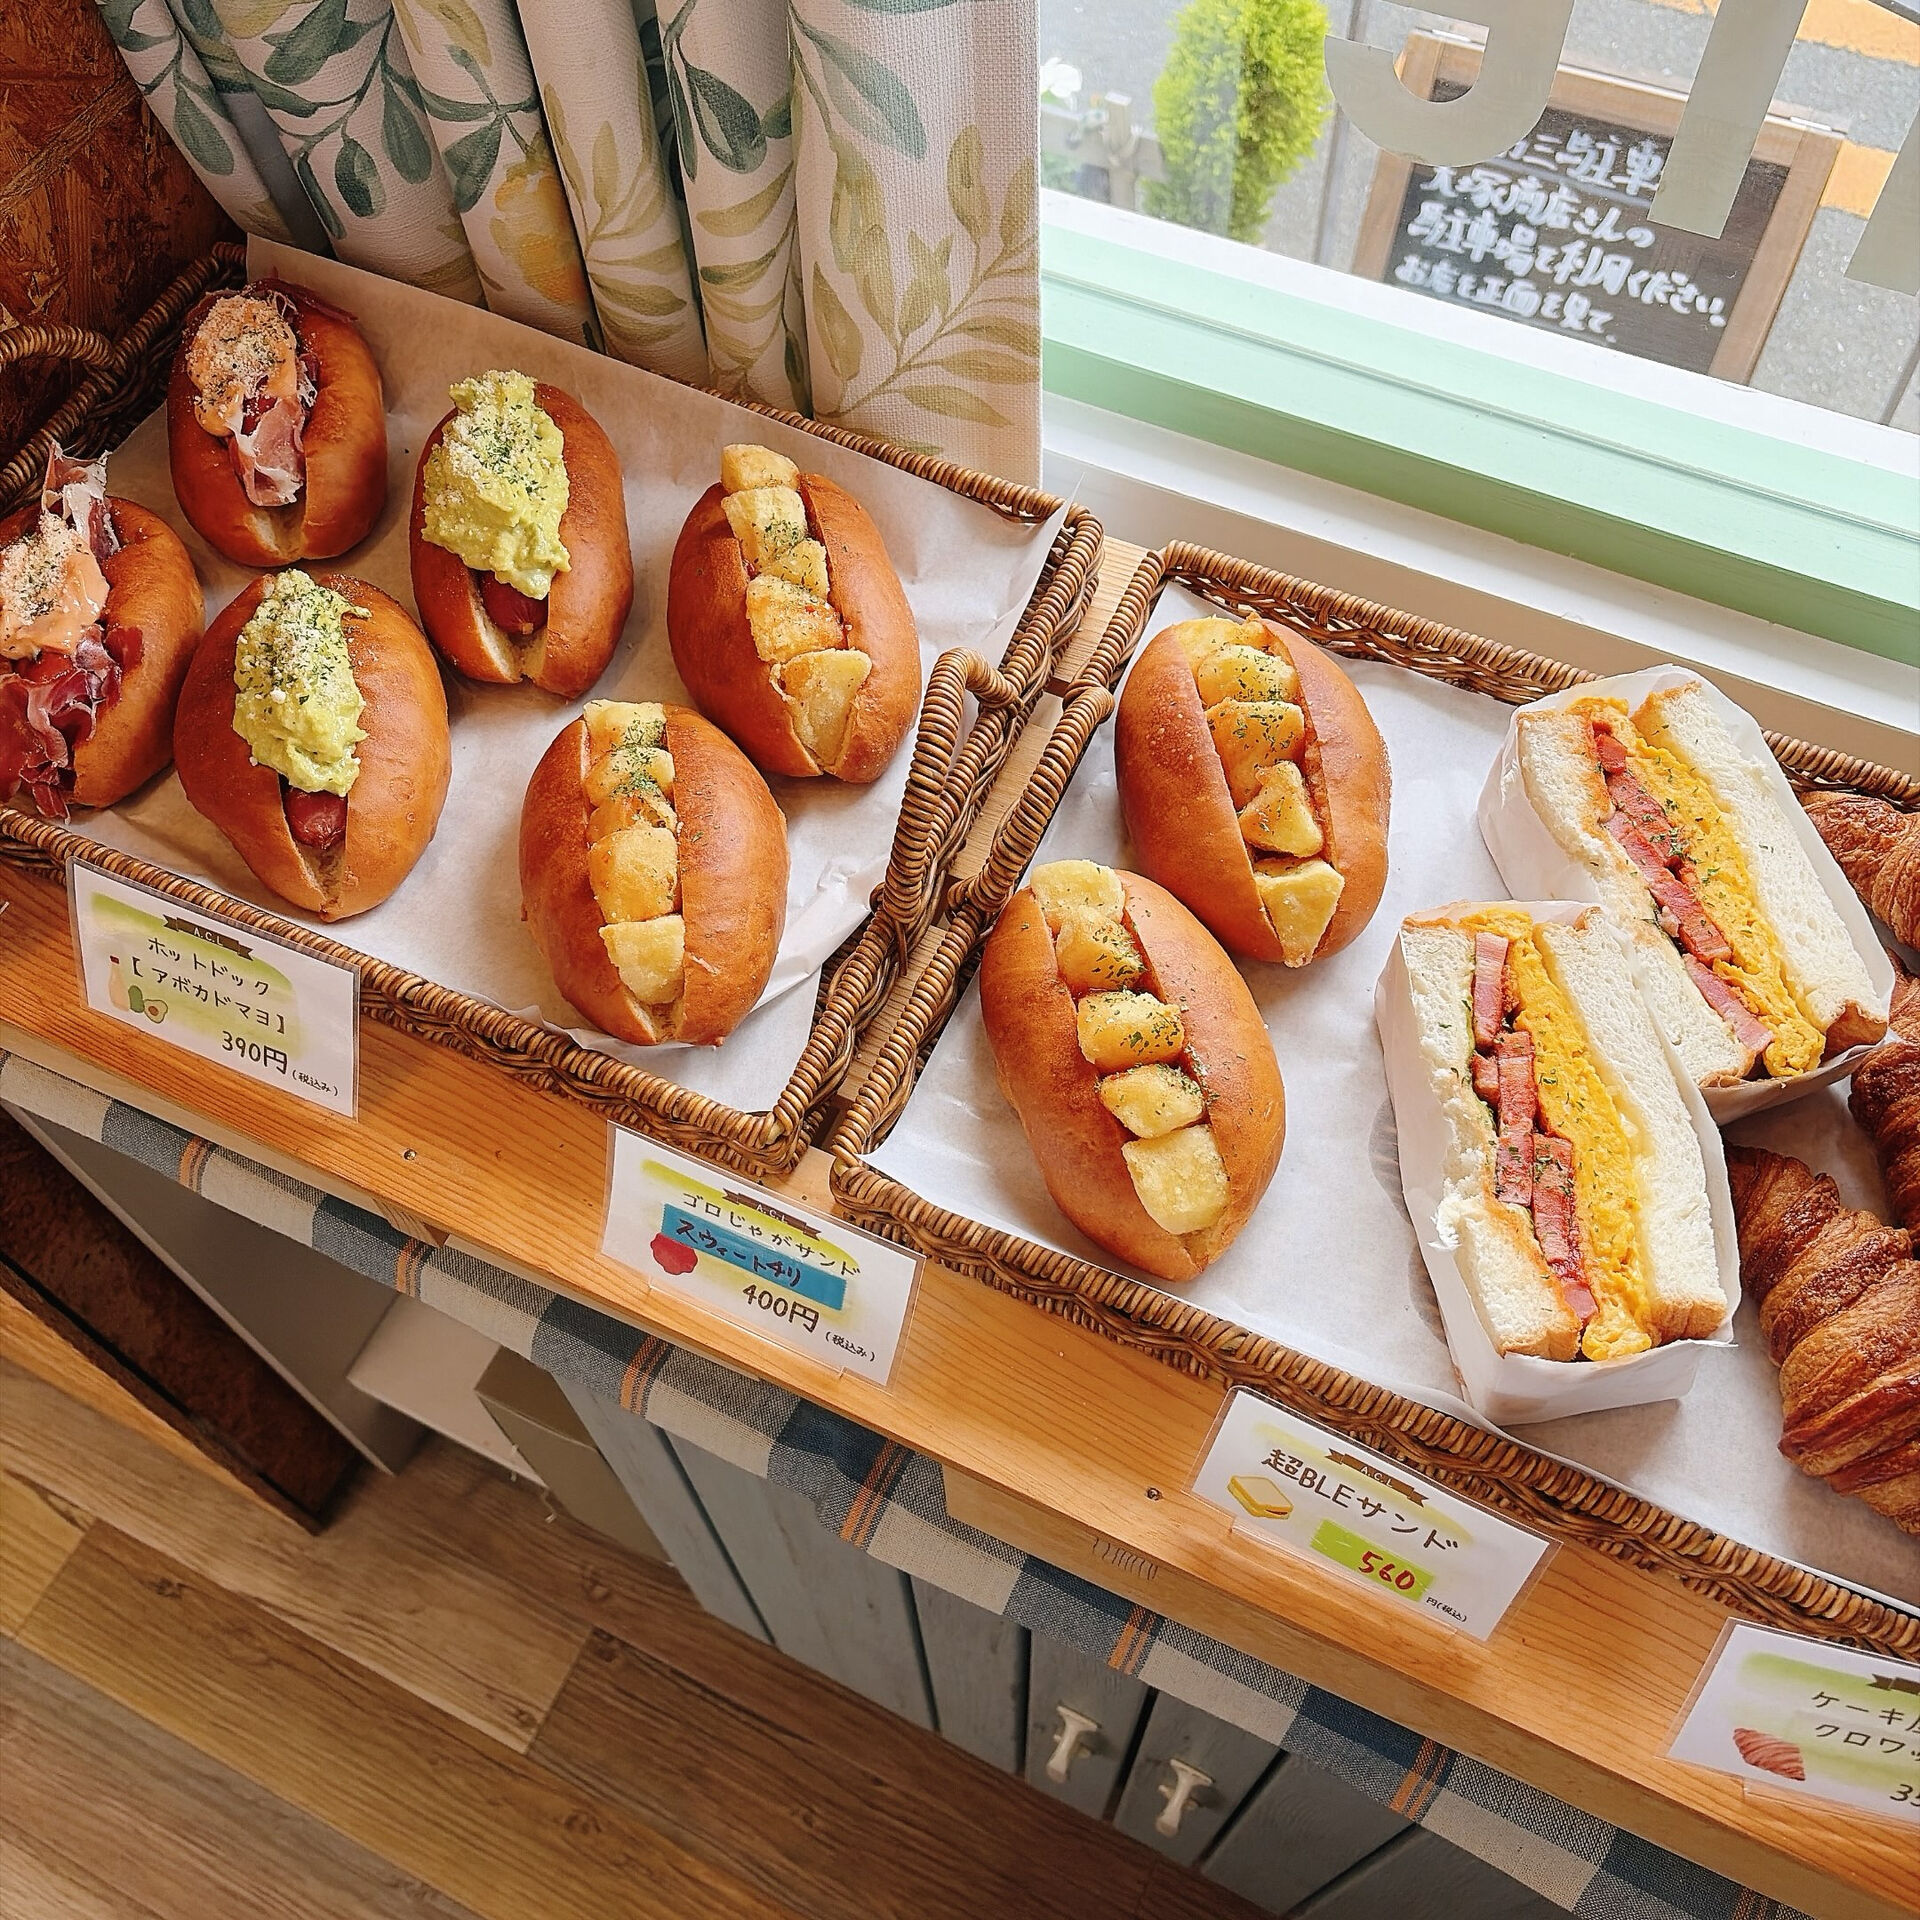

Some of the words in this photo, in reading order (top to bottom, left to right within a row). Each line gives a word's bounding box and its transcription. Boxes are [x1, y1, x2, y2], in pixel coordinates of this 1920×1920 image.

[148, 937, 269, 996] ホットドック
[221, 1030, 288, 1074] 390円
[682, 1192, 861, 1277] ゴロじゃがサンド
[742, 1284, 820, 1333] 400円
[1260, 1448, 1459, 1550] 超BLEサンド
[1358, 1550, 1416, 1591] 560
